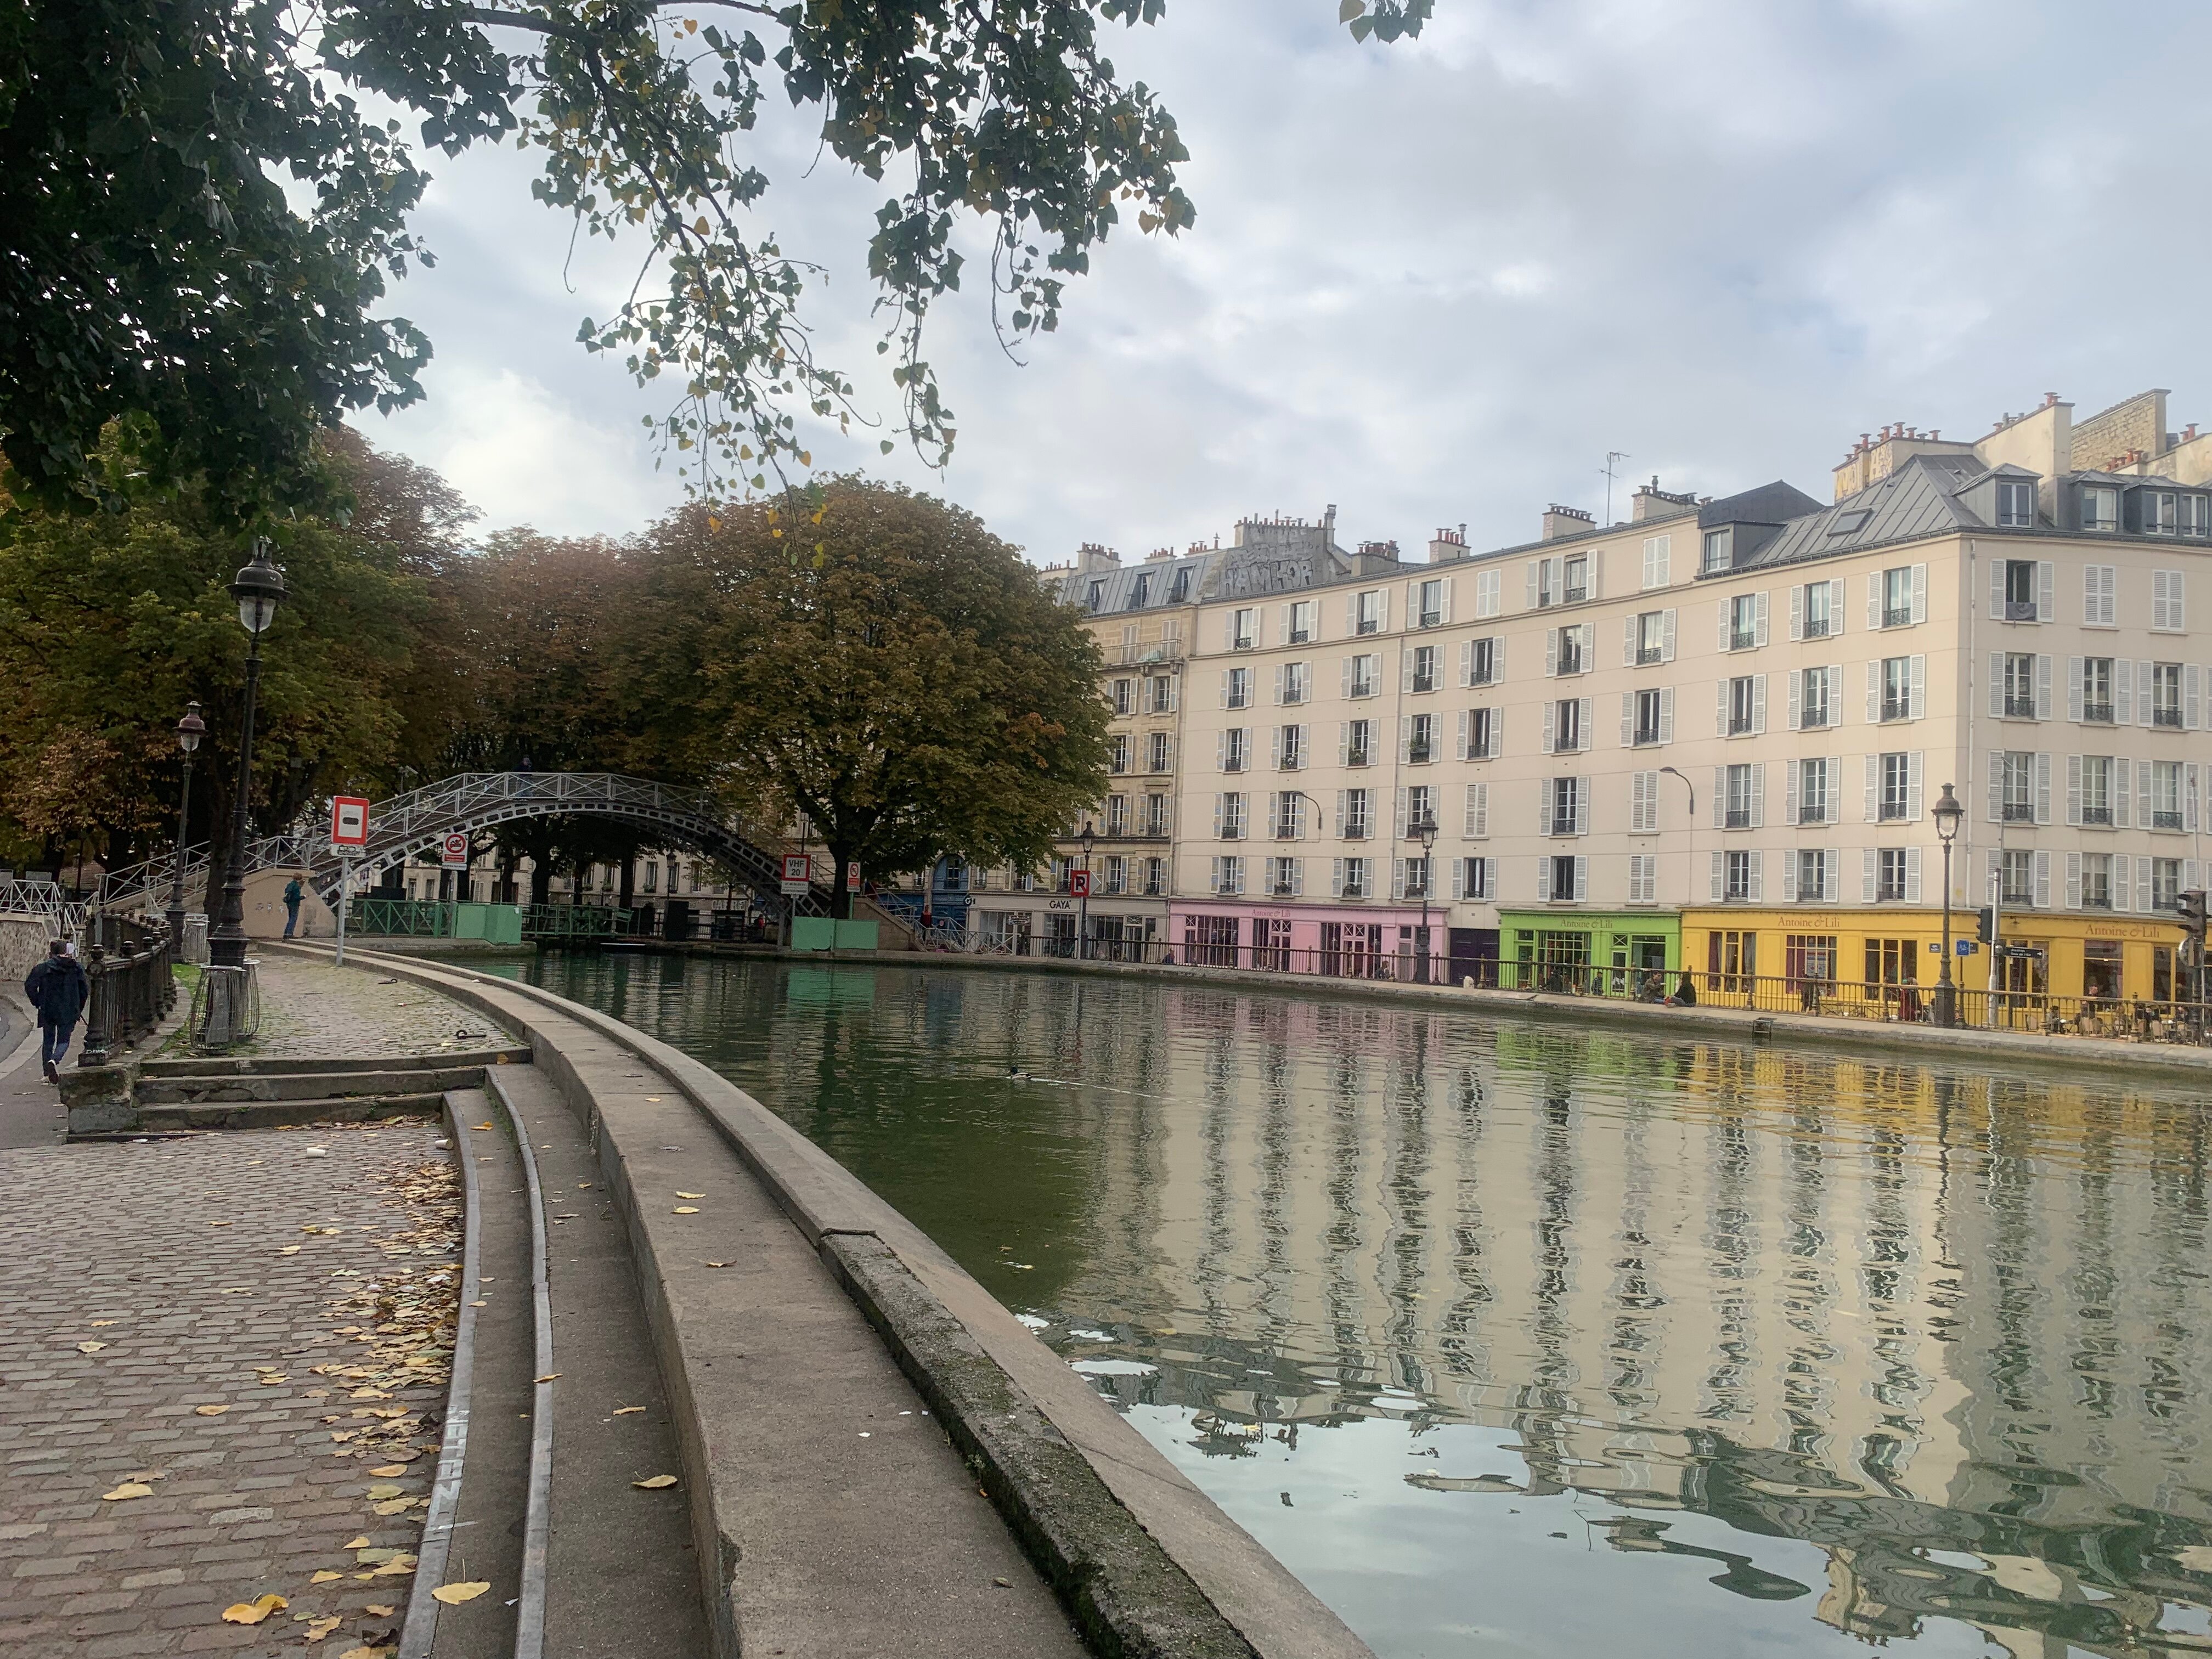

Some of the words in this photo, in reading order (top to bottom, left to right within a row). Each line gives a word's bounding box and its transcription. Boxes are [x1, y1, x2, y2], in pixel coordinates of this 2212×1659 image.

[789, 860, 804, 868] VHF
[1049, 900, 1071, 910] GAYA
[1274, 909, 1280, 917] &
[1560, 918, 1590, 928] Antoine
[1591, 918, 1599, 928] &
[1600, 919, 1613, 928] Lili
[1778, 917, 1813, 927] Antoine
[1814, 916, 1825, 927] &
[1825, 917, 1840, 928] Lili
[2085, 924, 2128, 936] Antoine
[2130, 925, 2140, 937] &
[2142, 926, 2160, 938] Lili
